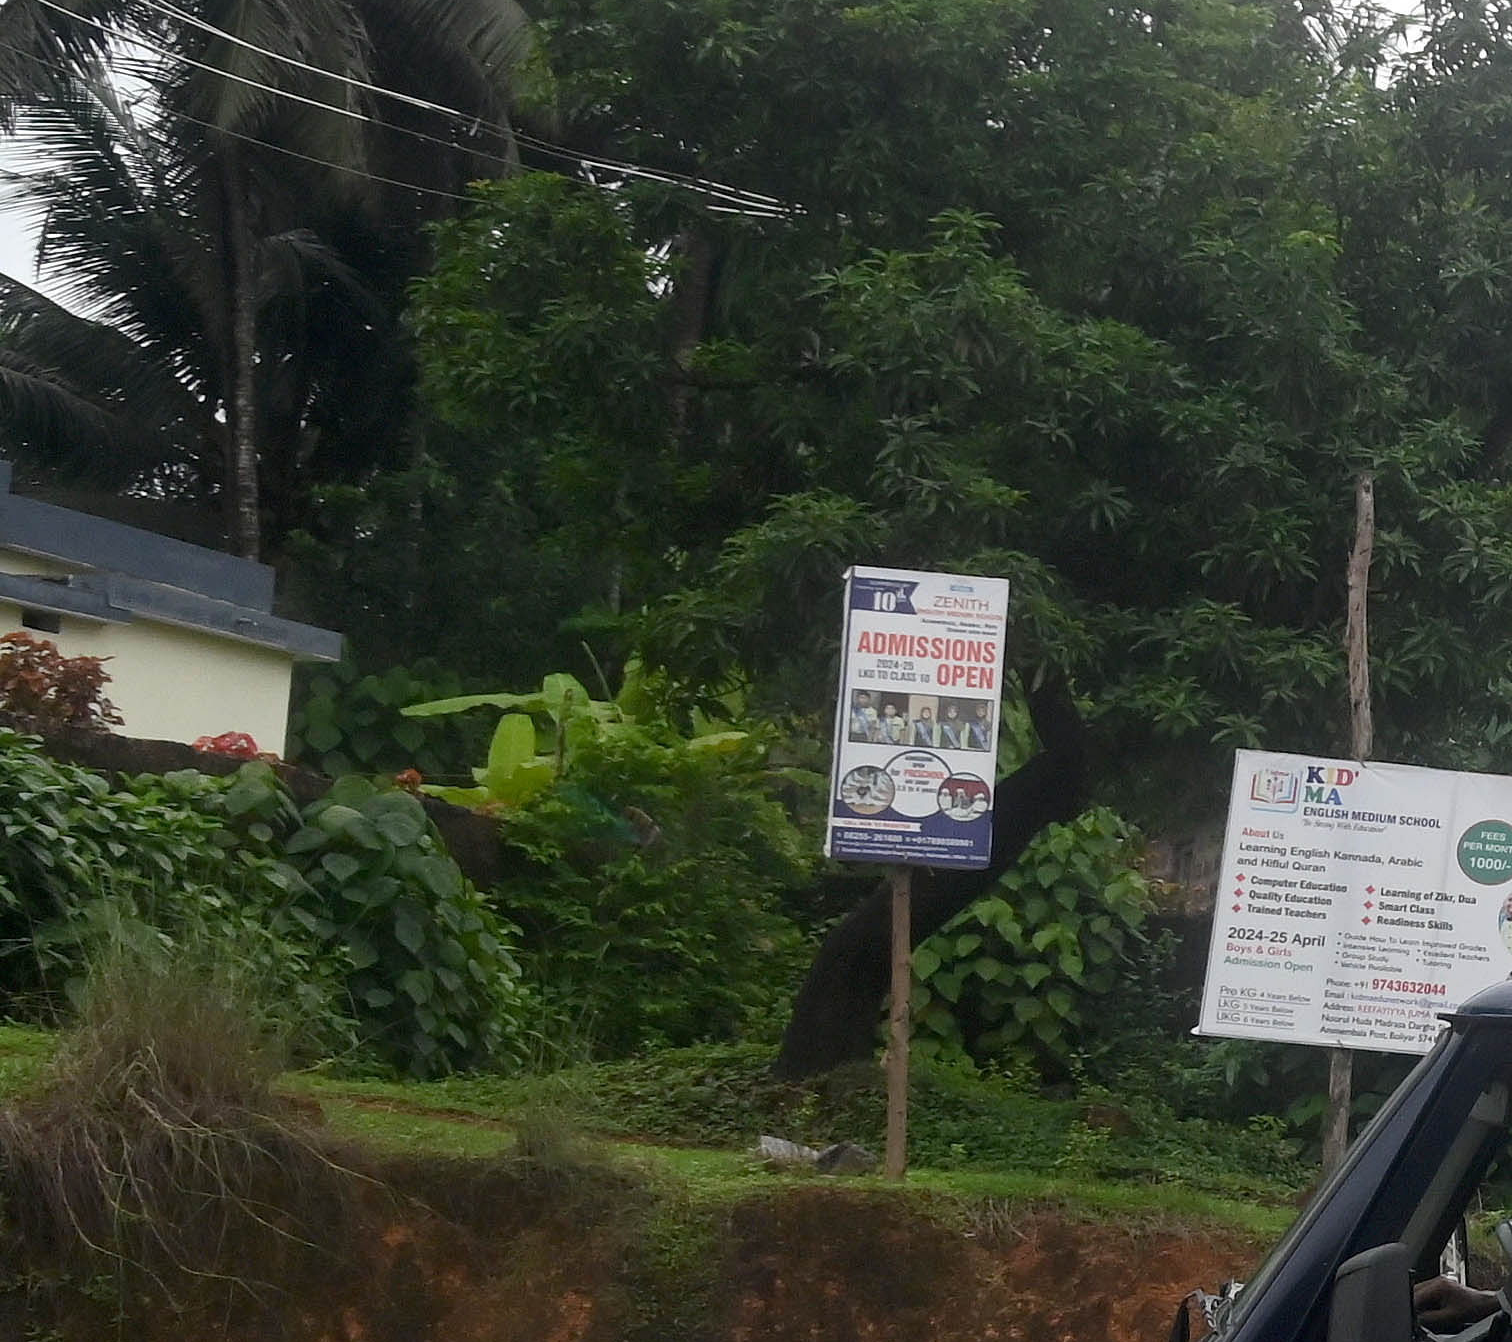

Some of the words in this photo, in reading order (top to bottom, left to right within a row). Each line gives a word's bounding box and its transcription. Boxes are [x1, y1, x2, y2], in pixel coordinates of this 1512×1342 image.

[933, 595, 990, 611] ZENITH
[857, 631, 997, 664] ADMISSIONS
[890, 671, 917, 682] CLASS
[936, 663, 995, 690] OPEN
[1304, 785, 1342, 806] MA
[1303, 806, 1349, 821] ENGLISH
[1351, 810, 1398, 826] MEDIUM
[1399, 814, 1441, 829] SCHOOL
[1242, 826, 1271, 839] About
[1272, 830, 1285, 840] Us
[1480, 829, 1507, 843] FEES
[1239, 842, 1287, 858] Learning
[1290, 845, 1331, 861] English
[1333, 849, 1385, 865] Kannada,
[1388, 855, 1424, 868] Arabic
[1462, 841, 1483, 854] PER
[1236, 856, 1258, 868] and
[1292, 861, 1327, 874] Quran
[1468, 855, 1512, 871] 1000/-
[1250, 875, 1298, 891] Computer
[1300, 880, 1348, 893] Education
[1248, 890, 1283, 905] Quality
[1284, 893, 1333, 906] Education
[1380, 886, 1422, 902] Learning
[1423, 891, 1433, 902] of
[1458, 894, 1477, 906] Dua
[1247, 903, 1282, 917] Trained
[1284, 906, 1328, 920] Teachers
[1378, 901, 1407, 914] Smart
[1409, 903, 1436, 916] Class
[1376, 915, 1426, 930] Readiness
[1427, 919, 1454, 932] Skills
[1227, 926, 1289, 943] 2024-25
[1291, 929, 1327, 948] April
[1225, 942, 1253, 956] Boys
[1255, 945, 1265, 955] &
[1267, 946, 1293, 958] Girls
[1223, 955, 1281, 971] Admission
[1283, 960, 1314, 974] Open
[1371, 978, 1447, 997] 9743632044
